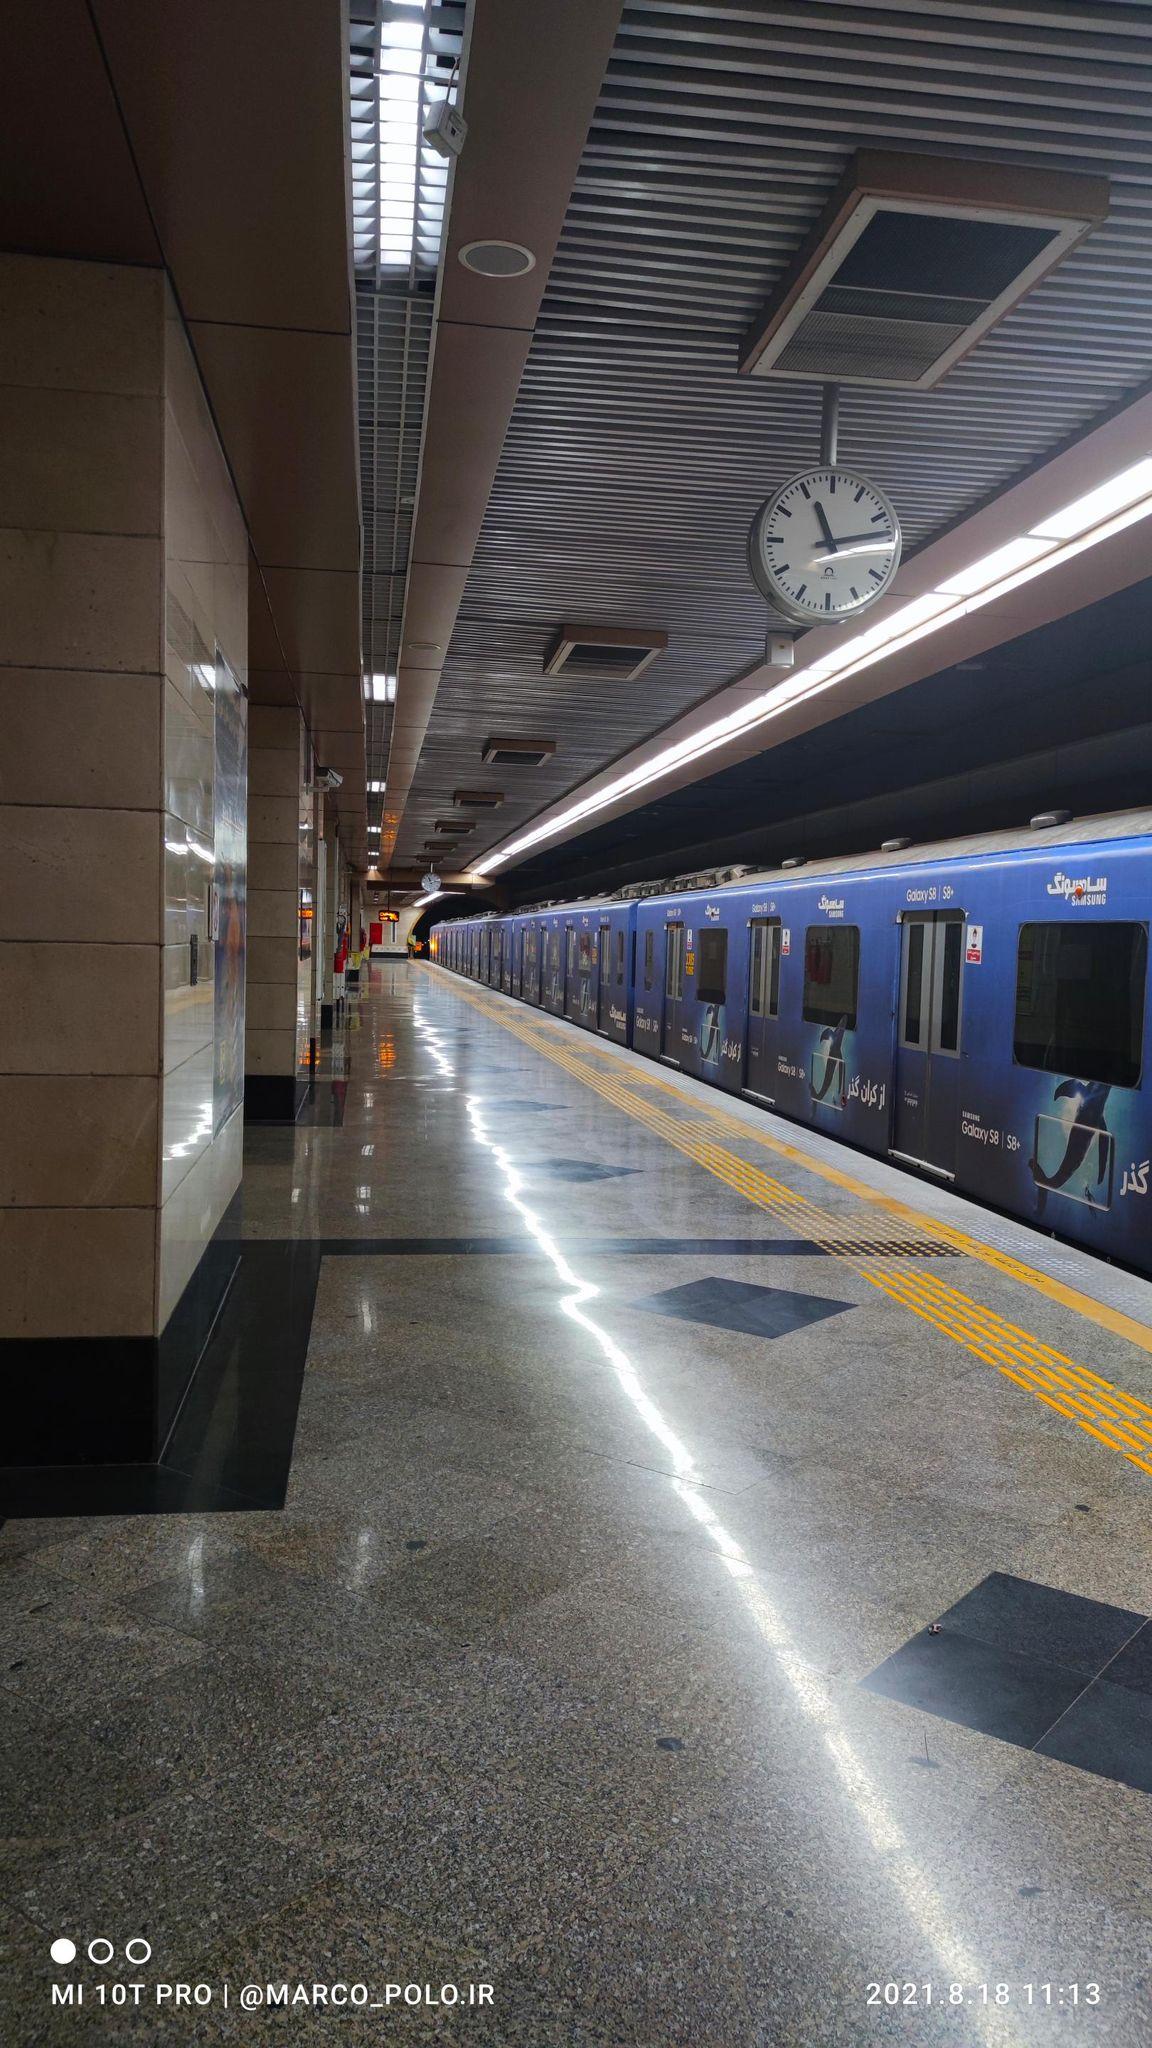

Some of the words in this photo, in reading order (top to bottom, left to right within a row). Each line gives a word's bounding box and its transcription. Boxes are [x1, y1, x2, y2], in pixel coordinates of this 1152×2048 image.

[906, 888, 928, 904] Galaxy
[1071, 893, 1107, 907] SAMSUNG
[961, 1121, 989, 1145] Galaxy
[989, 1128, 999, 1145] S8
[1006, 1134, 1021, 1151] S8+
[1119, 1159, 1150, 1196] گذر
